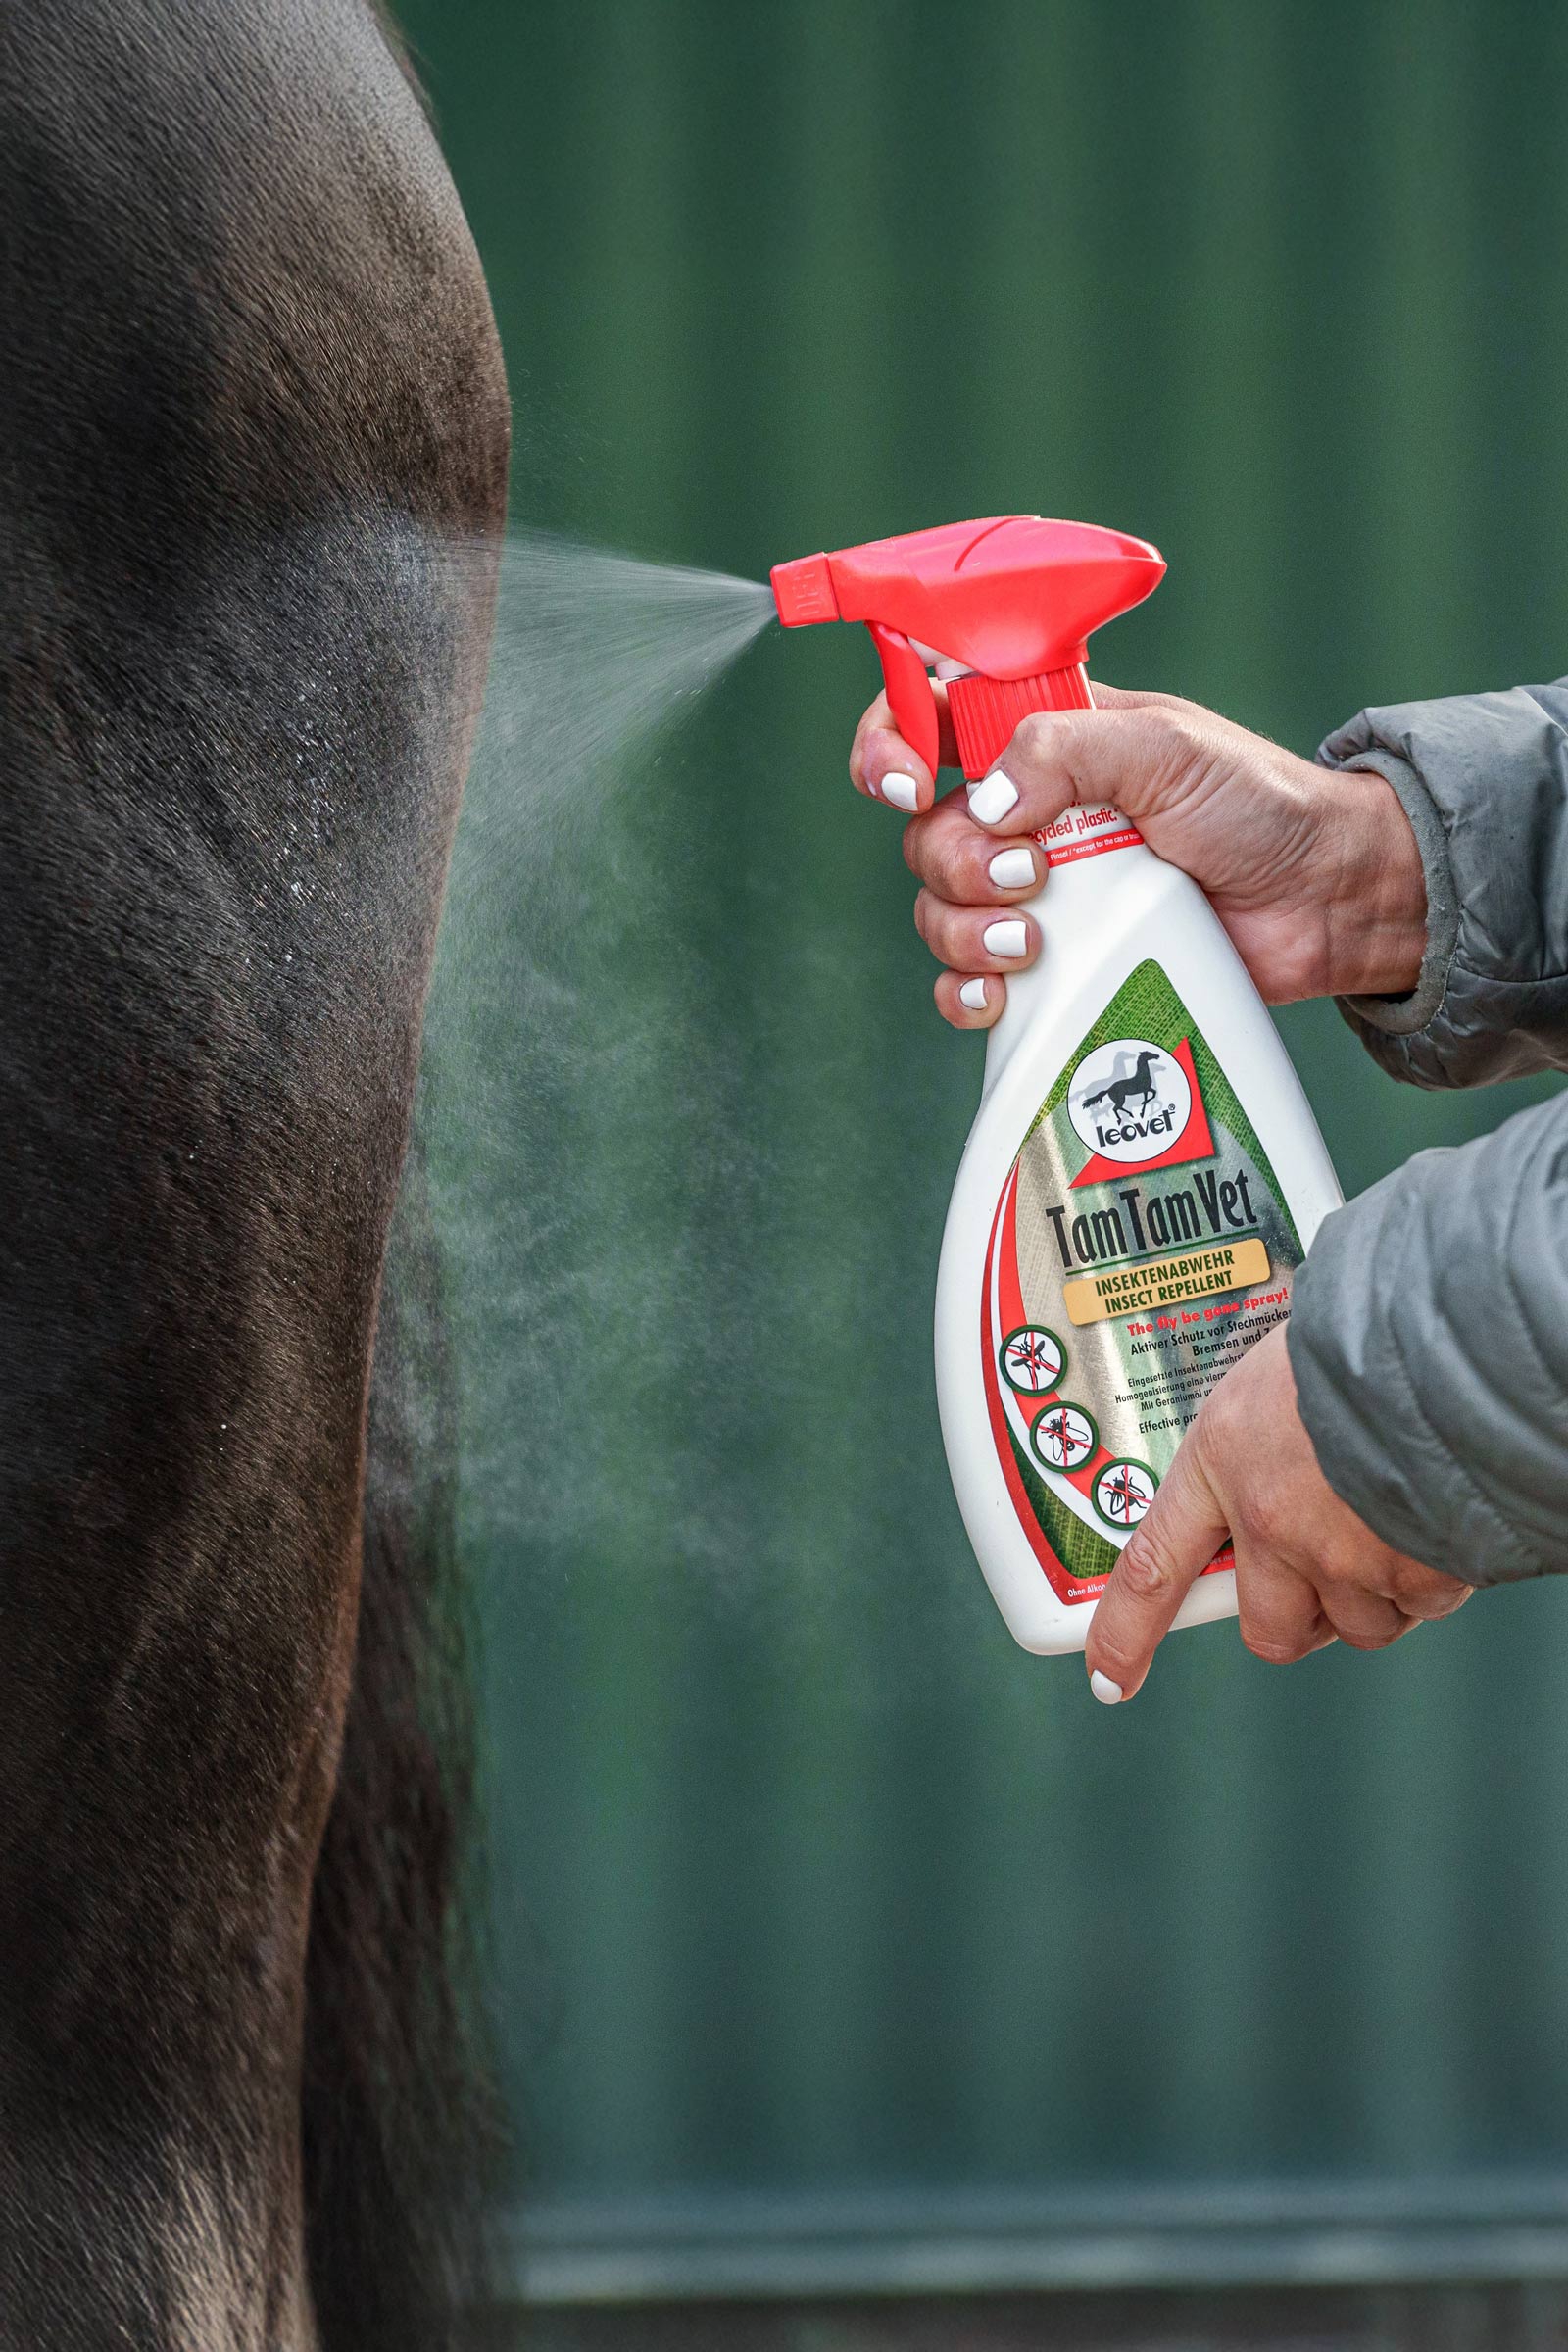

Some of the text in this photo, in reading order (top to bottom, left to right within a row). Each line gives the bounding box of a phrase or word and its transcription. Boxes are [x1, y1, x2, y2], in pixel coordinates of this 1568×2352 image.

[1028, 814, 1074, 846] ecycled
[1113, 835, 1124, 844] cap
[1095, 1250, 1235, 1297] INSEKTENABWEHR
[1105, 1270, 1233, 1314] INSECT REPELLENT
[1127, 1287, 1290, 1337] The fly be gone spray!
[1131, 1338, 1170, 1356] Aktiver
[1171, 1330, 1206, 1347] Schutz
[1207, 1325, 1225, 1337] vor
[1193, 1338, 1240, 1356] Bremsen
[1242, 1329, 1262, 1346] und
[1115, 1382, 1185, 1403] Homogenisierung
[1187, 1376, 1205, 1388] eine
[1128, 1371, 1173, 1388] Eingesetzte
[1141, 1400, 1154, 1412] Mit
[1156, 1389, 1203, 1408] Geraniumöl
[1139, 1416, 1181, 1434] Effective
[1067, 1586, 1086, 1598] Ohne
